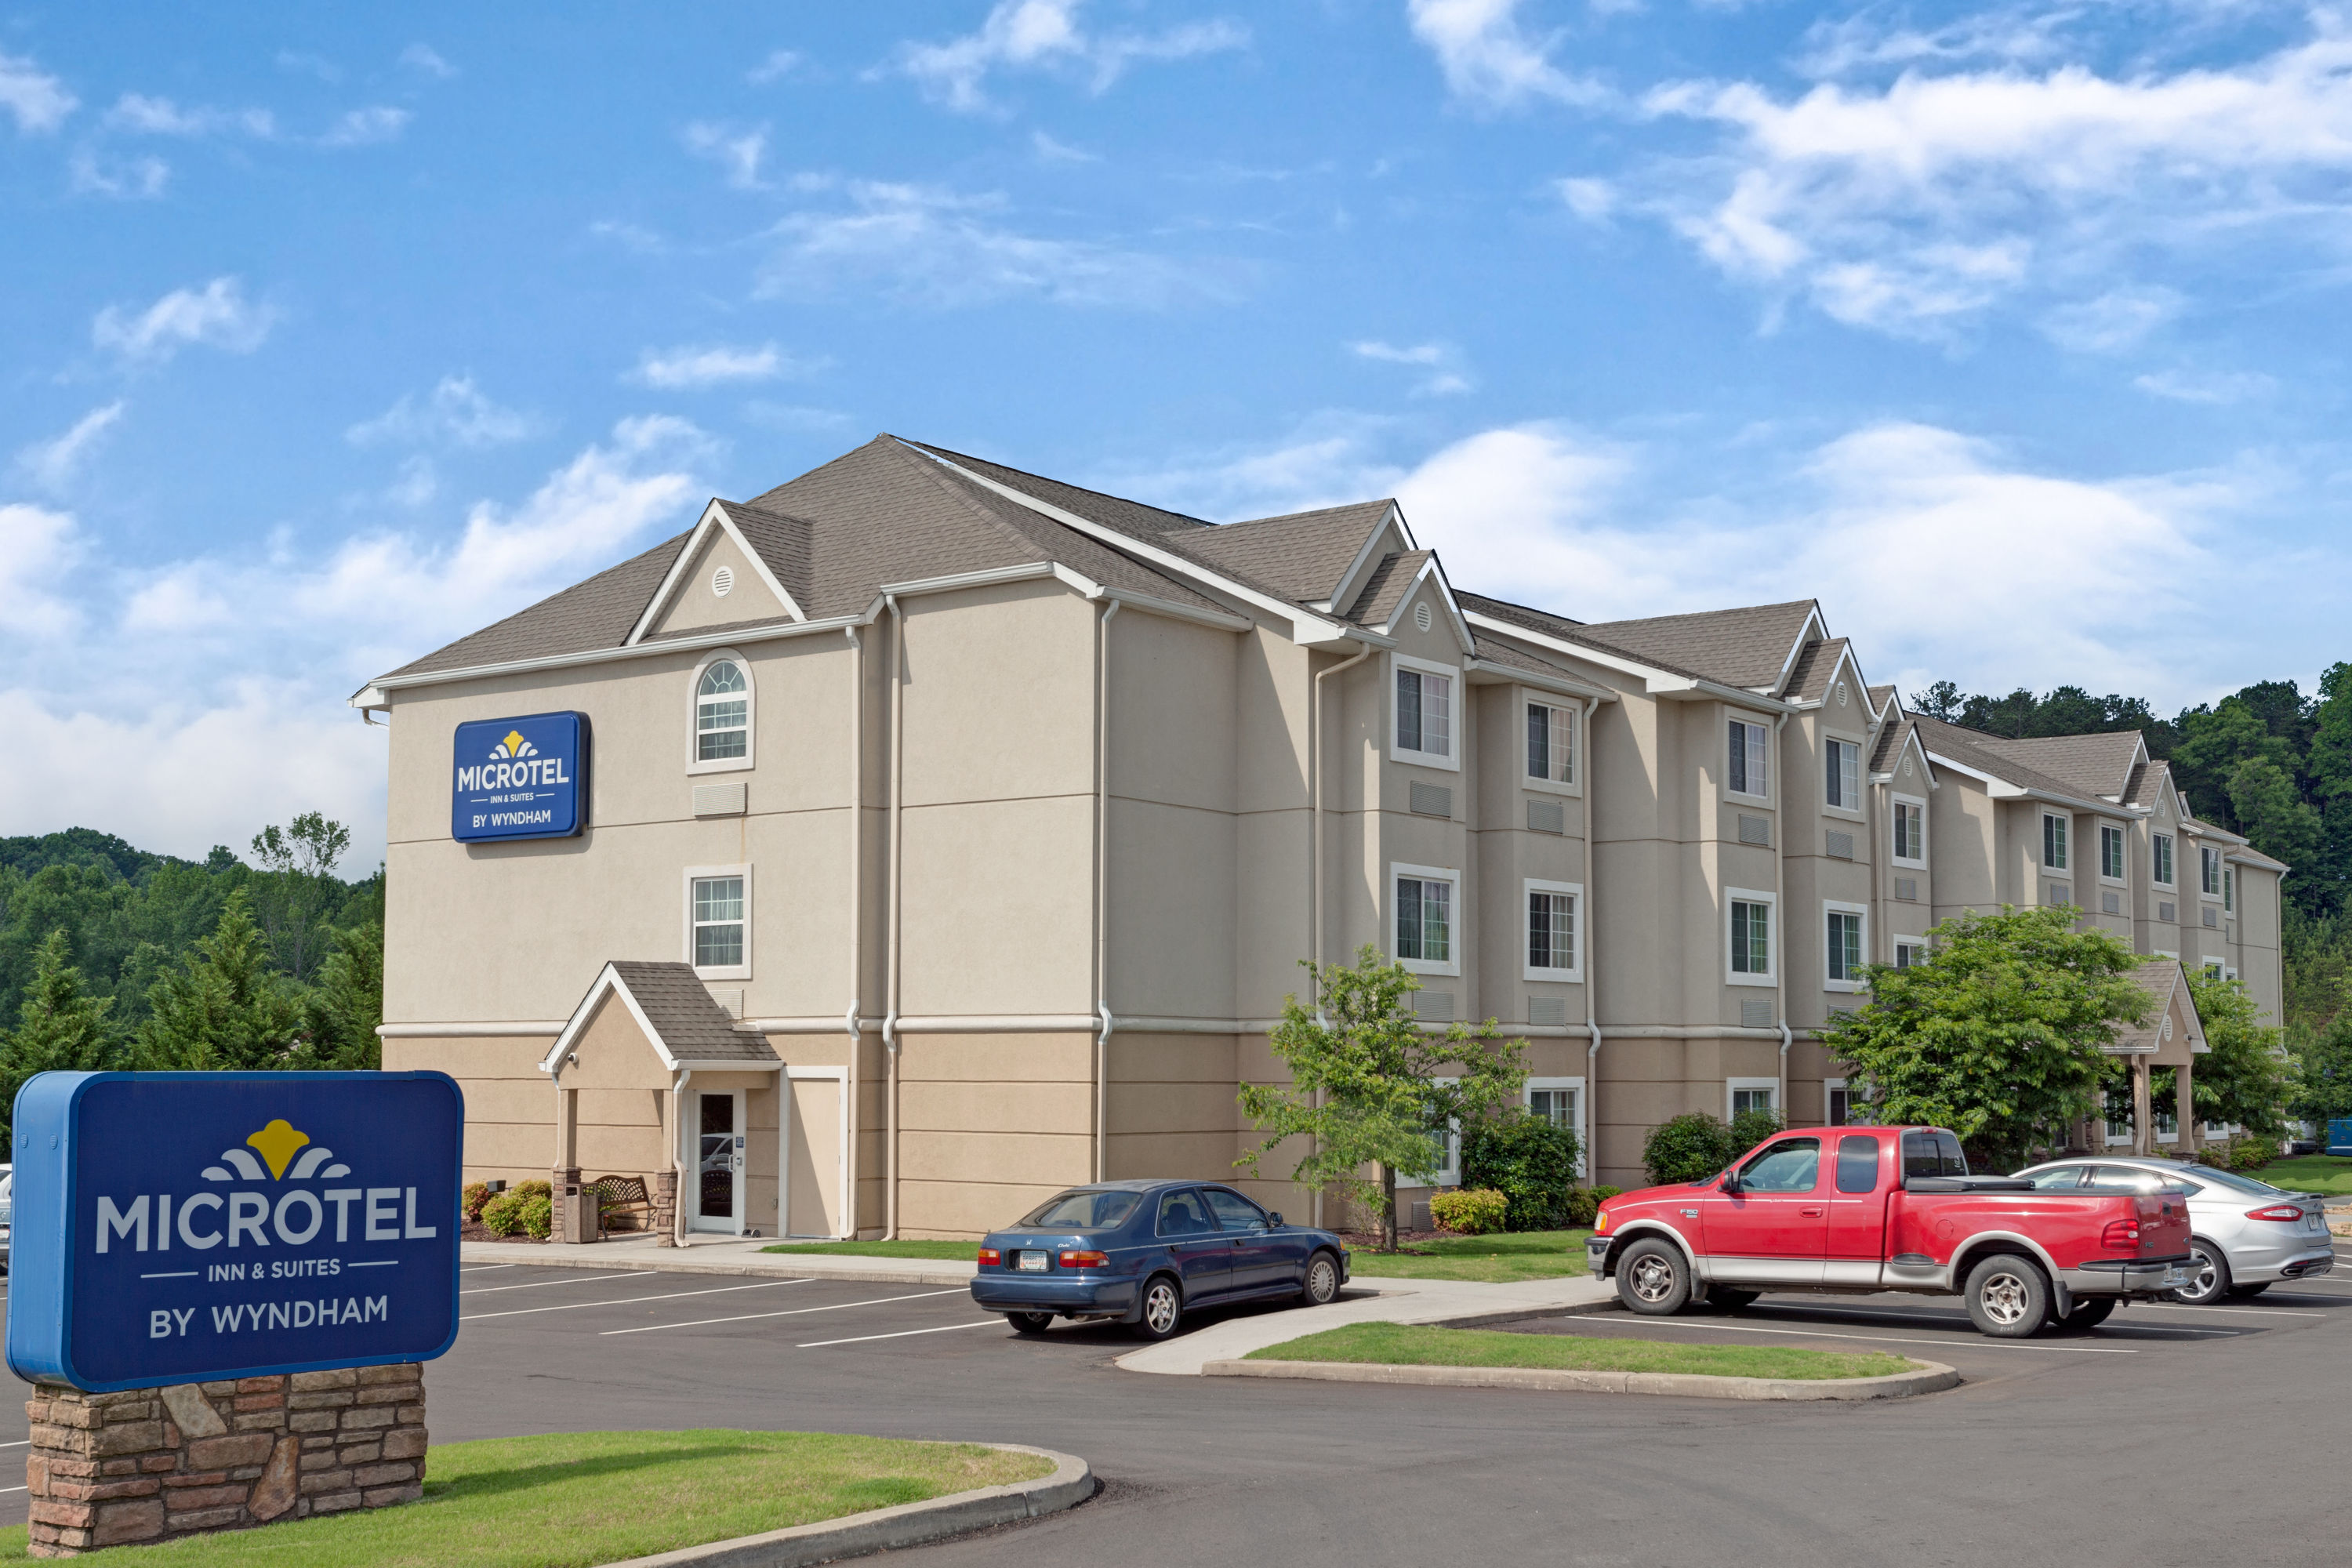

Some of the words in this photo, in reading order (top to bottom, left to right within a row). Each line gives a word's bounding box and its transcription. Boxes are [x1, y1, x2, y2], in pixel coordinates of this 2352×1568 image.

[458, 757, 569, 792] MICROTEL
[490, 795, 503, 804] INN
[503, 794, 509, 803] &
[510, 792, 534, 802] SUITES
[473, 814, 488, 828] BY
[491, 809, 551, 826] WYNDHAM
[96, 1187, 437, 1254] MICROTEL
[209, 1263, 245, 1282] INN
[252, 1262, 264, 1279] &
[271, 1258, 340, 1279] SUITES
[150, 1308, 196, 1338] BY
[211, 1295, 387, 1334] WYNDHAM
